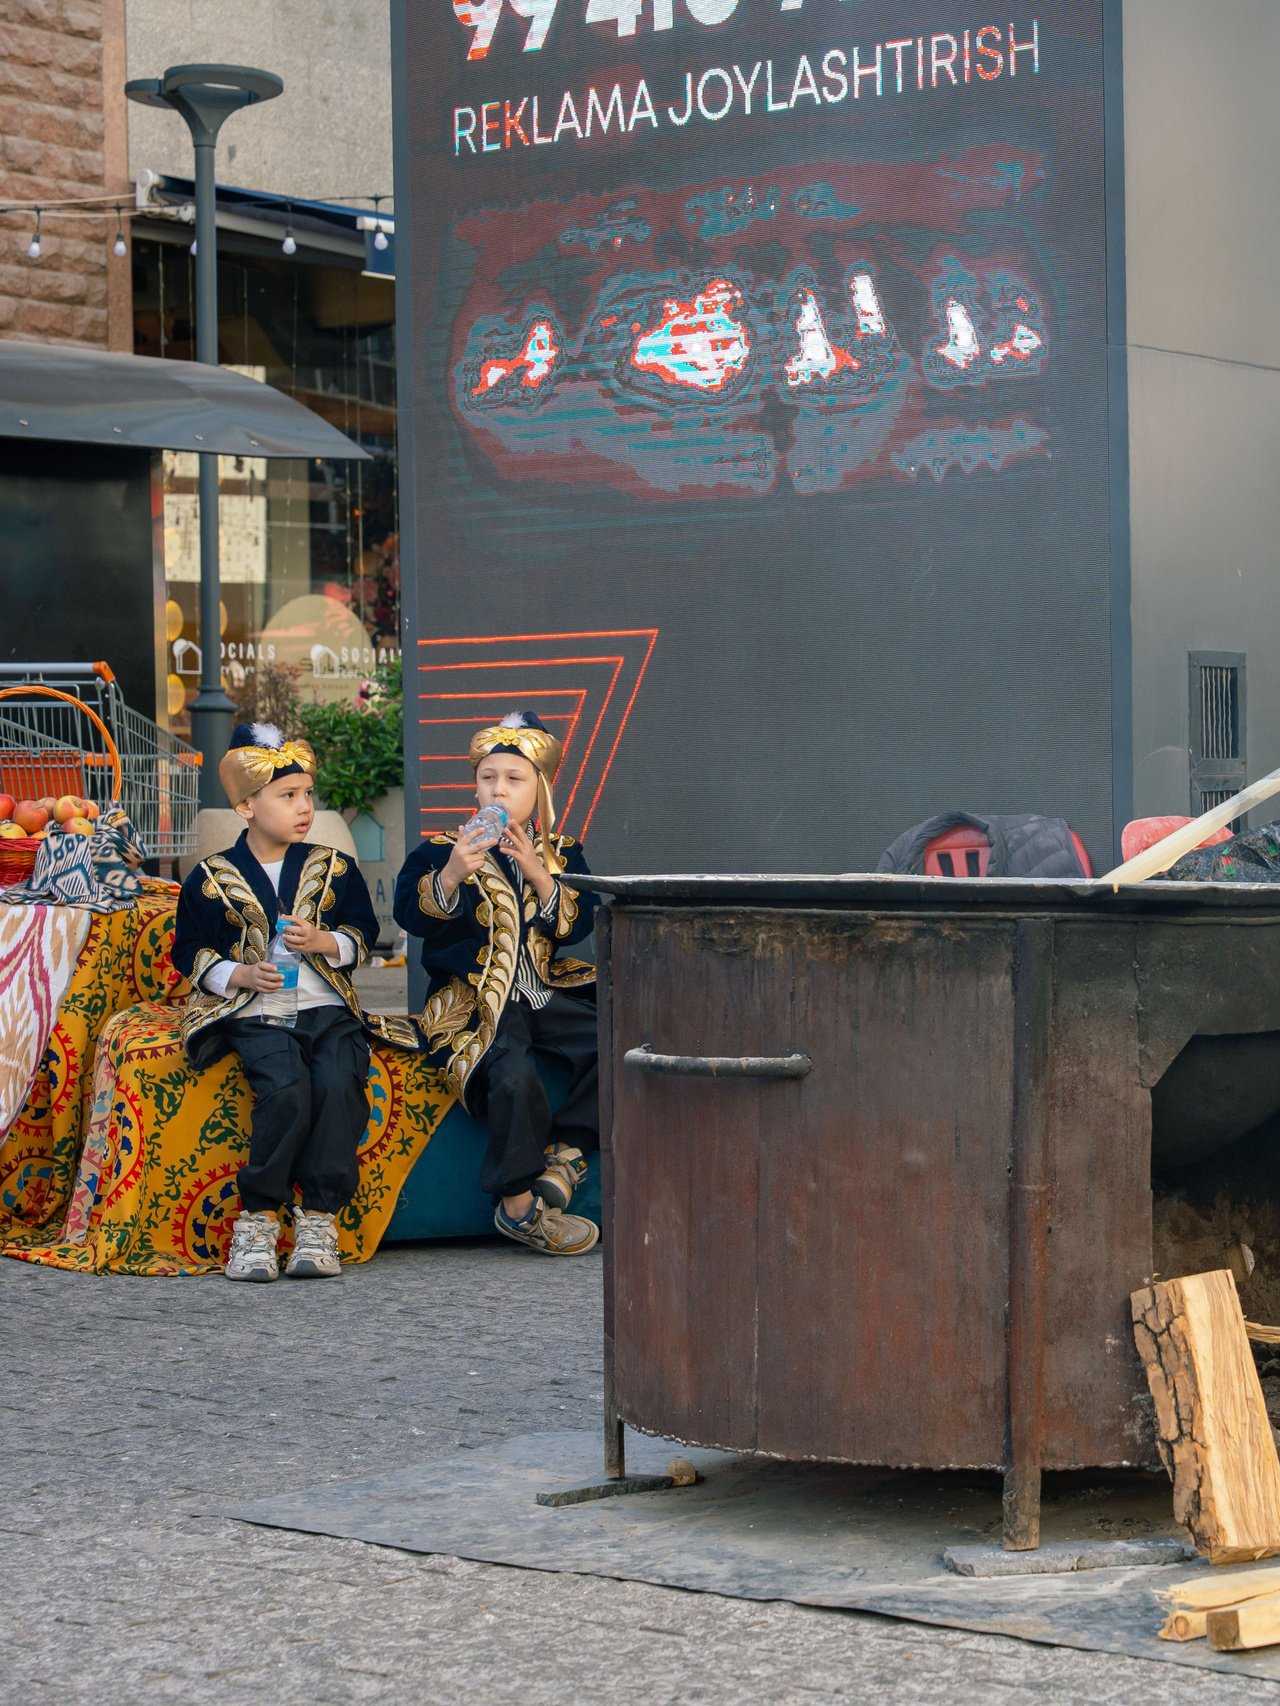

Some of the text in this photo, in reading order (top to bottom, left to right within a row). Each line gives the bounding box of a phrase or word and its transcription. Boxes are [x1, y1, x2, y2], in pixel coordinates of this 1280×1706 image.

[453, 18, 1040, 156] REKLAMA JOYLASHTIRISH
[220, 641, 276, 661] OCIALS
